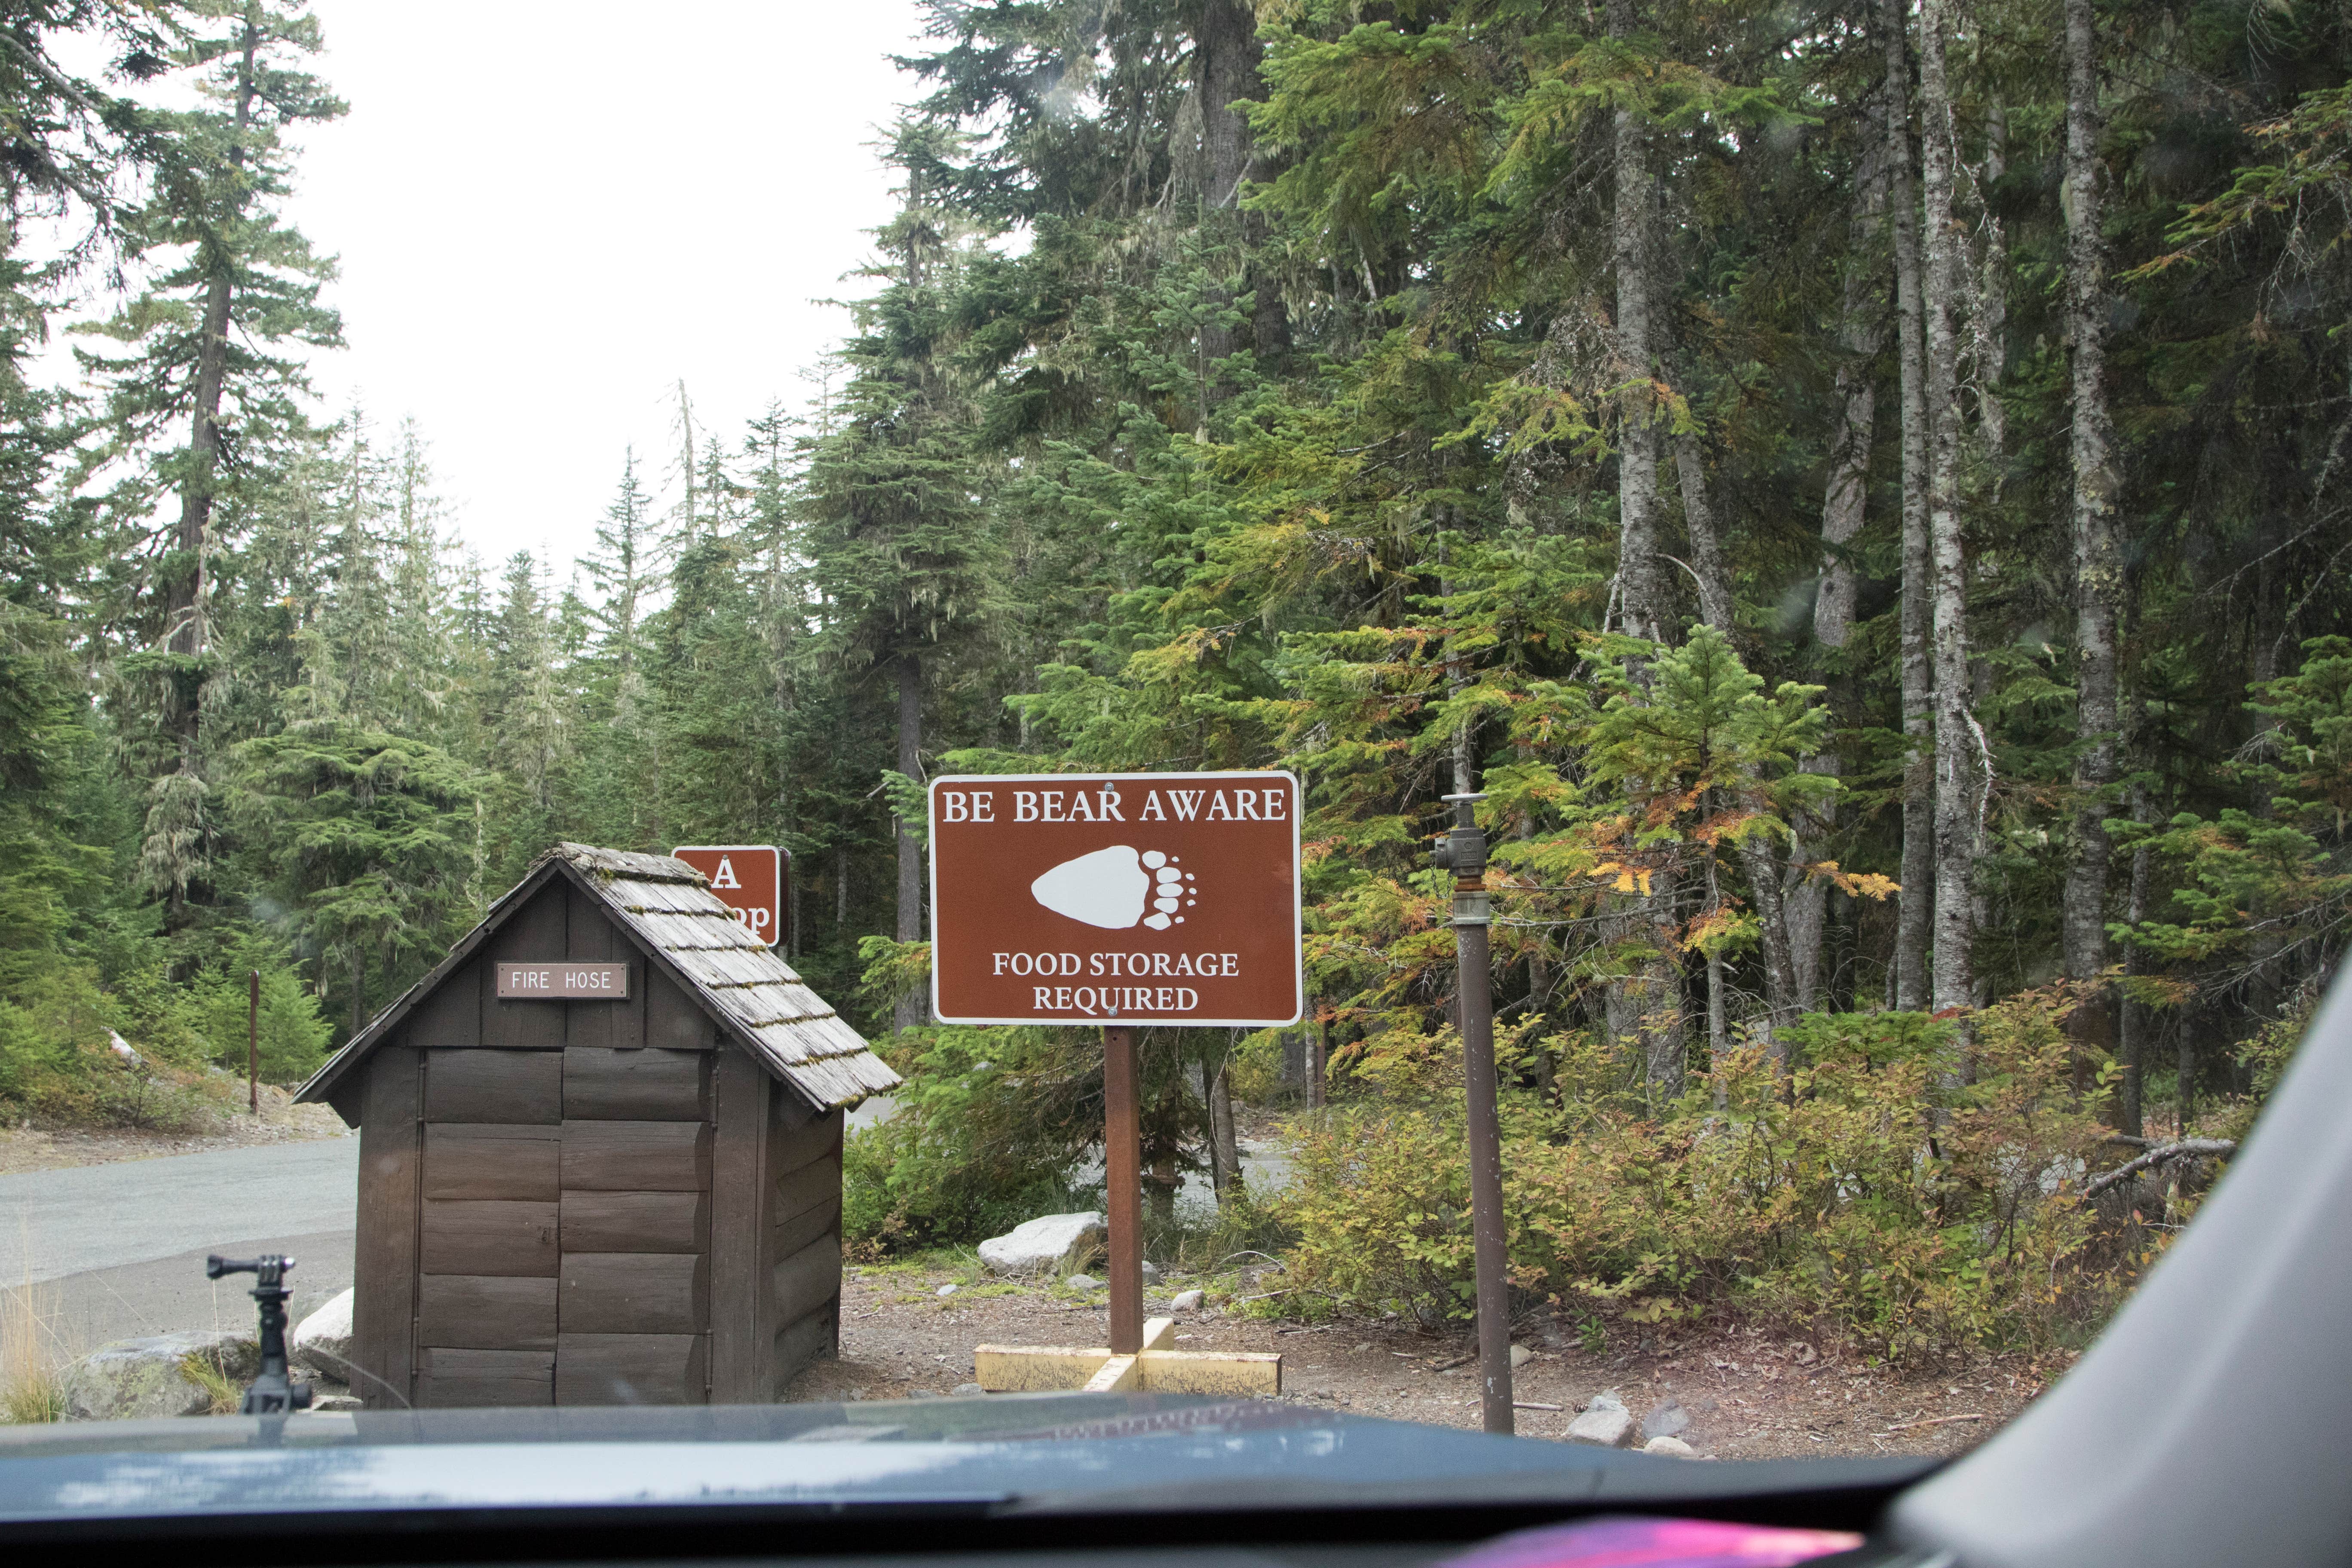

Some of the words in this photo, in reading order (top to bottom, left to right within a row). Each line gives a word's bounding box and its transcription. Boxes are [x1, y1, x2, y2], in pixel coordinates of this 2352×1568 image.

[943, 791, 995, 823] BE
[1013, 790, 1126, 822] BEAR
[1139, 789, 1286, 821] AWARE
[710, 859, 741, 888] A
[992, 952, 1081, 976] FOOD
[1090, 952, 1240, 977] STORAGE
[512, 971, 549, 989] FIRE
[566, 971, 611, 989] HOSE
[1033, 987, 1198, 1016] REQUIRED
